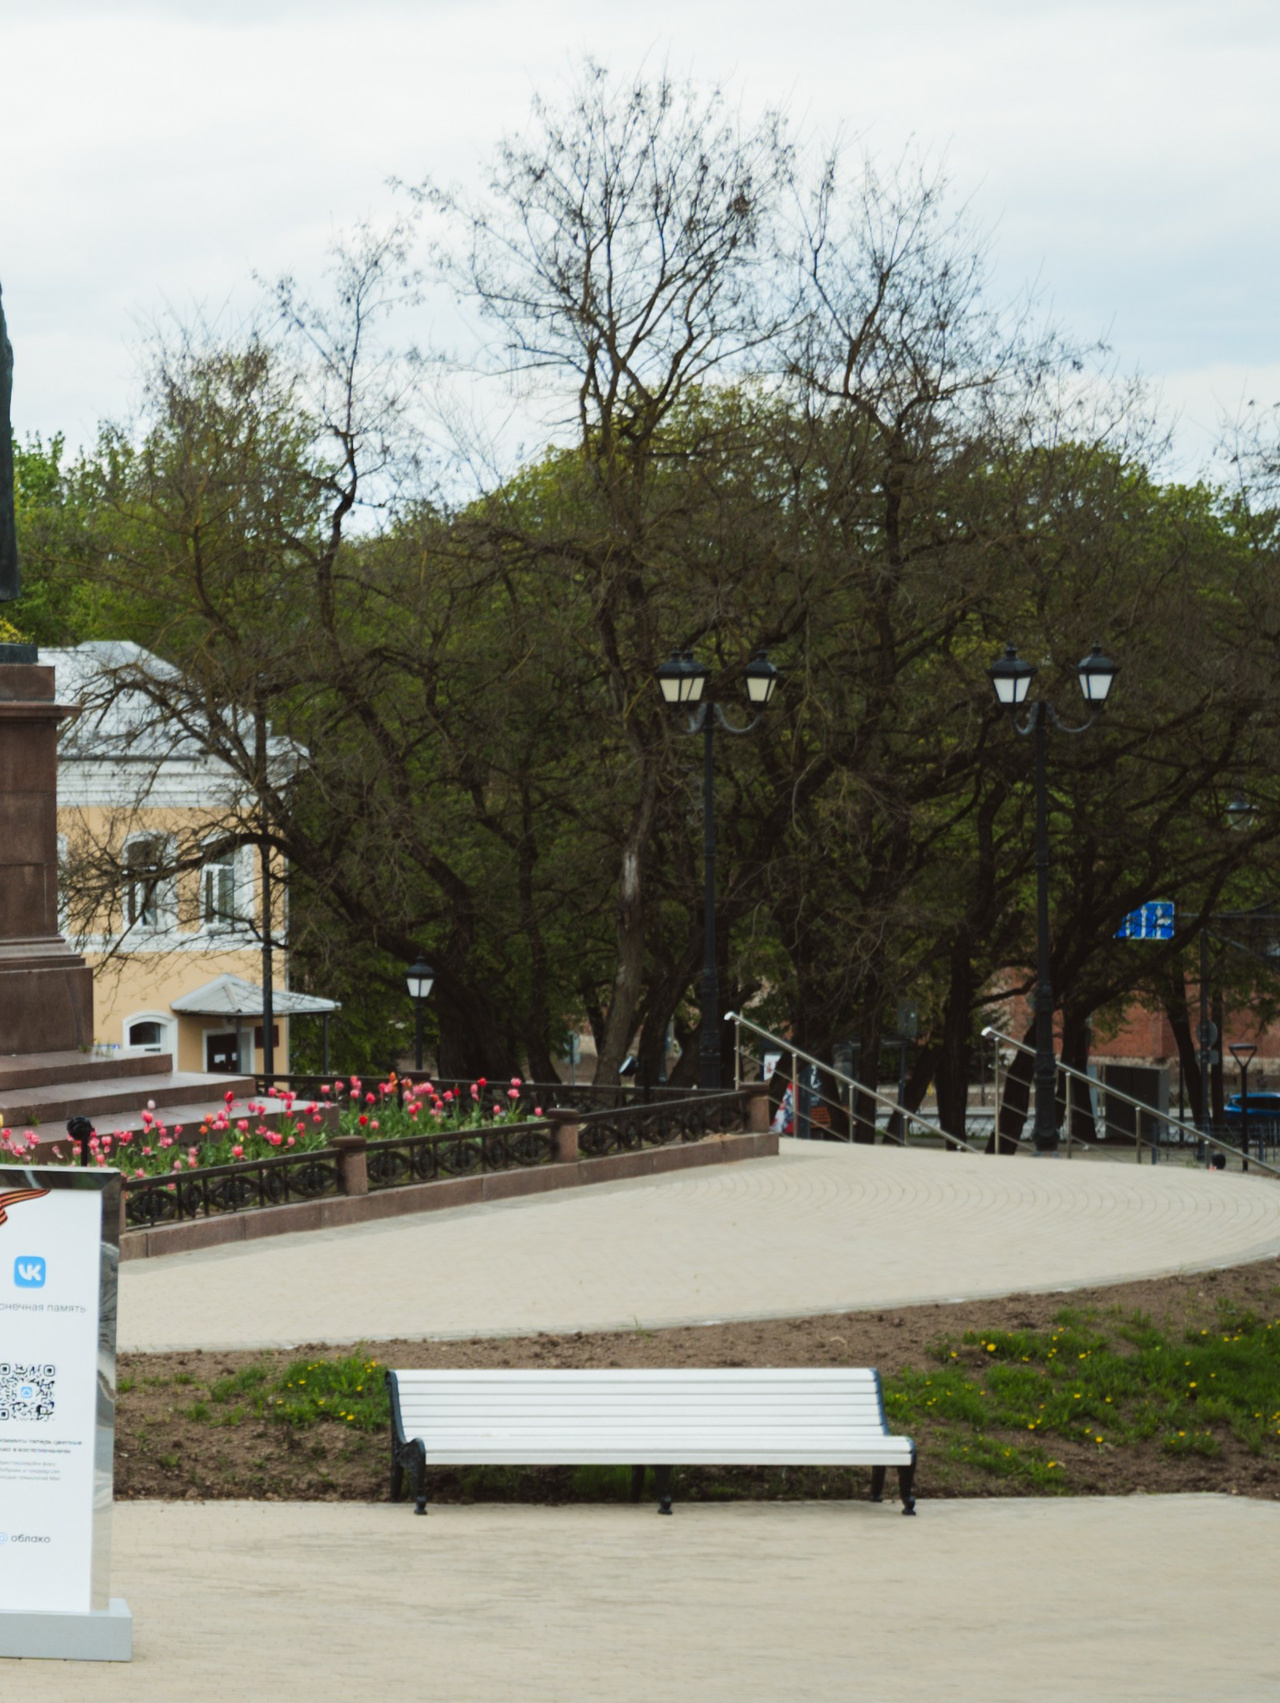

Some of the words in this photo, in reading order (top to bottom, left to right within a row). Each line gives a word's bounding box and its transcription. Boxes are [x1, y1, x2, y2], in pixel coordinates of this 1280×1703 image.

[18, 1263, 42, 1281] VK
[47, 1302, 86, 1313] память
[10, 1533, 51, 1543] облако
